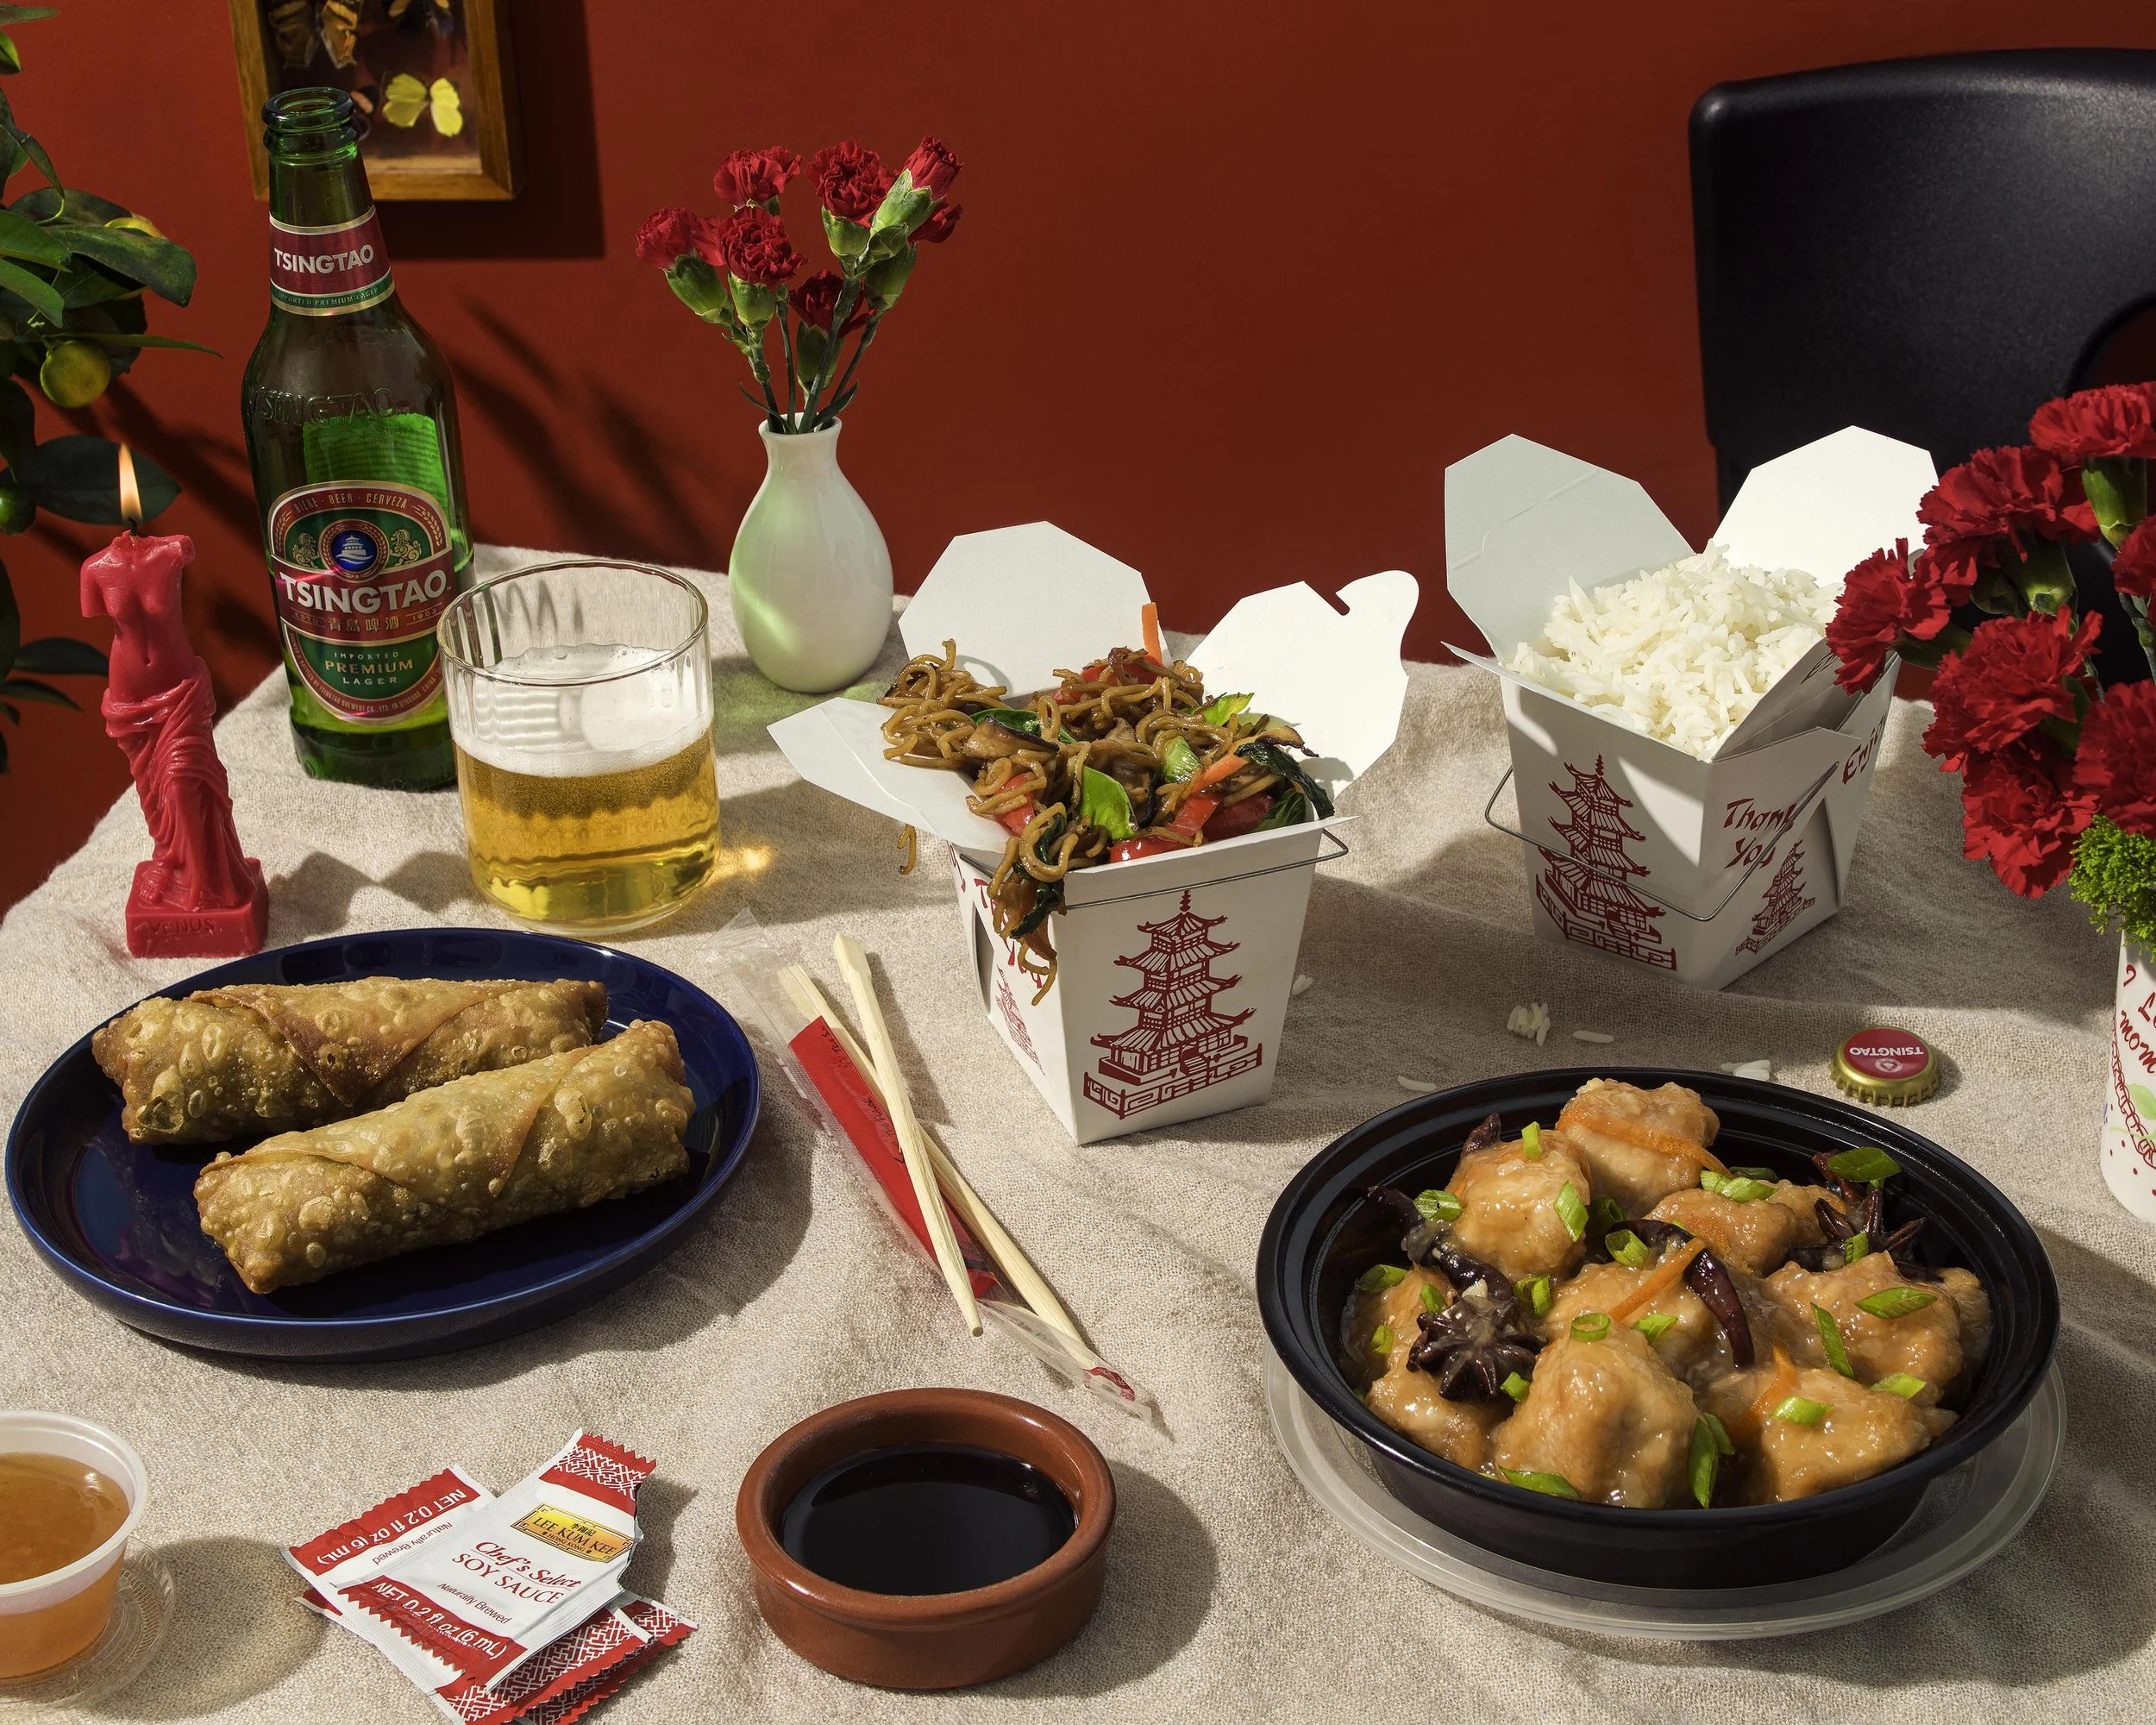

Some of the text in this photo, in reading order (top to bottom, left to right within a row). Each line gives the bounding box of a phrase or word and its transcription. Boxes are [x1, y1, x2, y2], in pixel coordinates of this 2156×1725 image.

[274, 244, 374, 274] TSINGTAO
[315, 296, 354, 305] PREMIUM
[328, 492, 353, 505] BEER
[367, 492, 408, 510] CERVEZA
[279, 569, 447, 614] TSINGTAO
[412, 608, 437, 621] 1903
[328, 616, 399, 632] 青島啤酒
[334, 651, 399, 660] IMPORTED
[324, 658, 414, 674] PREMIUM
[342, 676, 398, 686] LAGER
[319, 686, 341, 704] TSINGTAO
[148, 917, 215, 934] VENUS
[1849, 1046, 1924, 1057] TSINGTAO
[317, 1488, 467, 1565] NET 0.2 fl oz (6 mL)
[532, 1516, 617, 1555] LEE KUM KEE
[372, 1521, 453, 1565] Naturally Brewed
[547, 1534, 586, 1552] HONG KONG
[475, 1541, 582, 1588] Chef's Select
[451, 1553, 565, 1604] SOY SAUCE
[437, 1583, 513, 1624] Naturally Brewed
[372, 1582, 508, 1660] NET 0.2 fl oz (6 mL)
